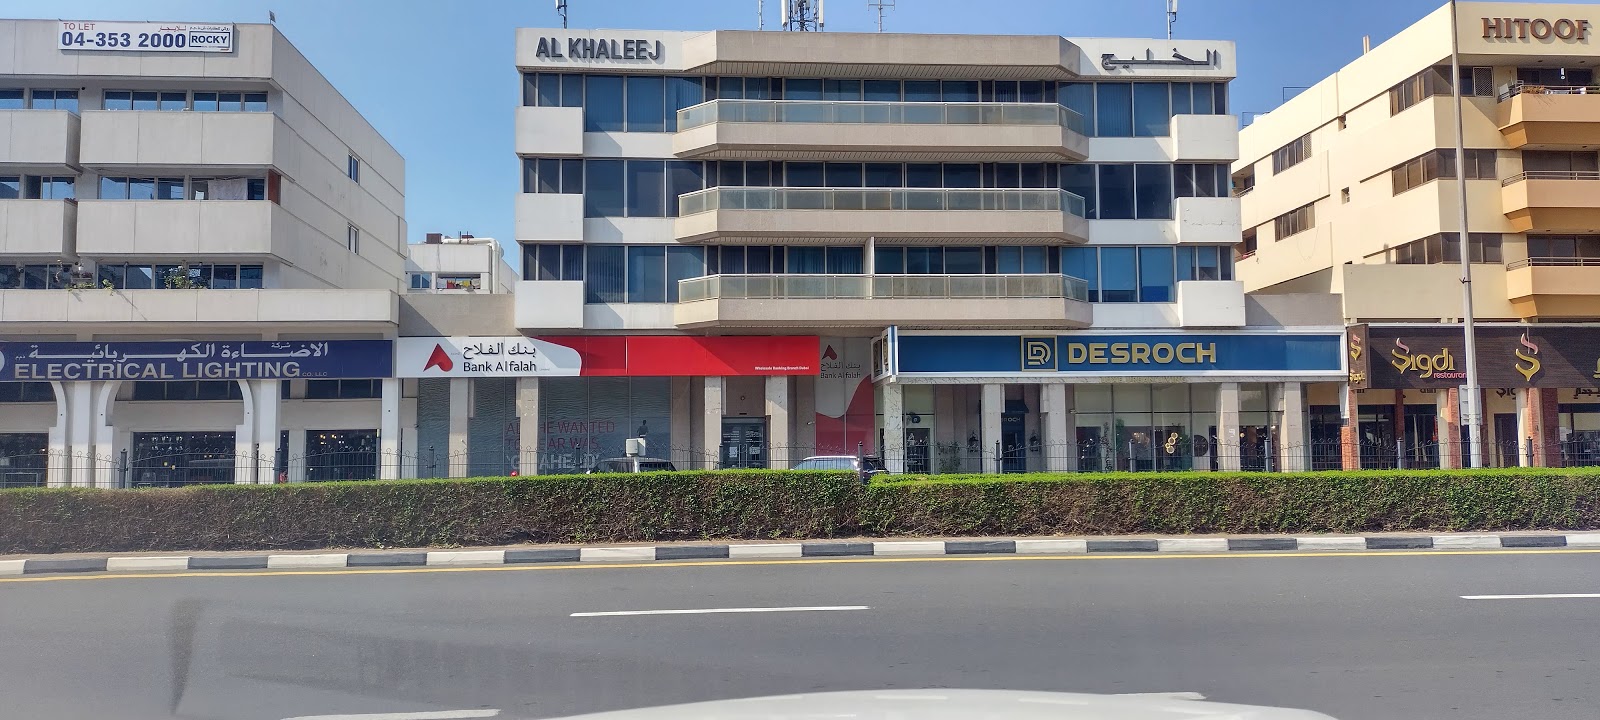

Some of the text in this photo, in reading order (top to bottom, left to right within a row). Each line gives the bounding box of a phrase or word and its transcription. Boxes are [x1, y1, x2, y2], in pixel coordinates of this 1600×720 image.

[63, 22, 95, 31] TO LET
[1481, 17, 1589, 40] HITOOF
[61, 31, 186, 48] 04-353 2000
[191, 35, 227, 44] ROCKY
[535, 36, 660, 60] AL KHALEEJ
[1101, 47, 1217, 70] الخليج
[463, 343, 536, 360] بنك الفلاح
[1068, 342, 1217, 364] DESROCH
[1391, 341, 1456, 379] Sigdi
[14, 362, 174, 379] ELECTRICAL
[182, 361, 300, 378] LIGHTING
[463, 361, 537, 372] Bank Alfalah
[557, 421, 616, 433] WANTED
[569, 437, 599, 449] WAS
